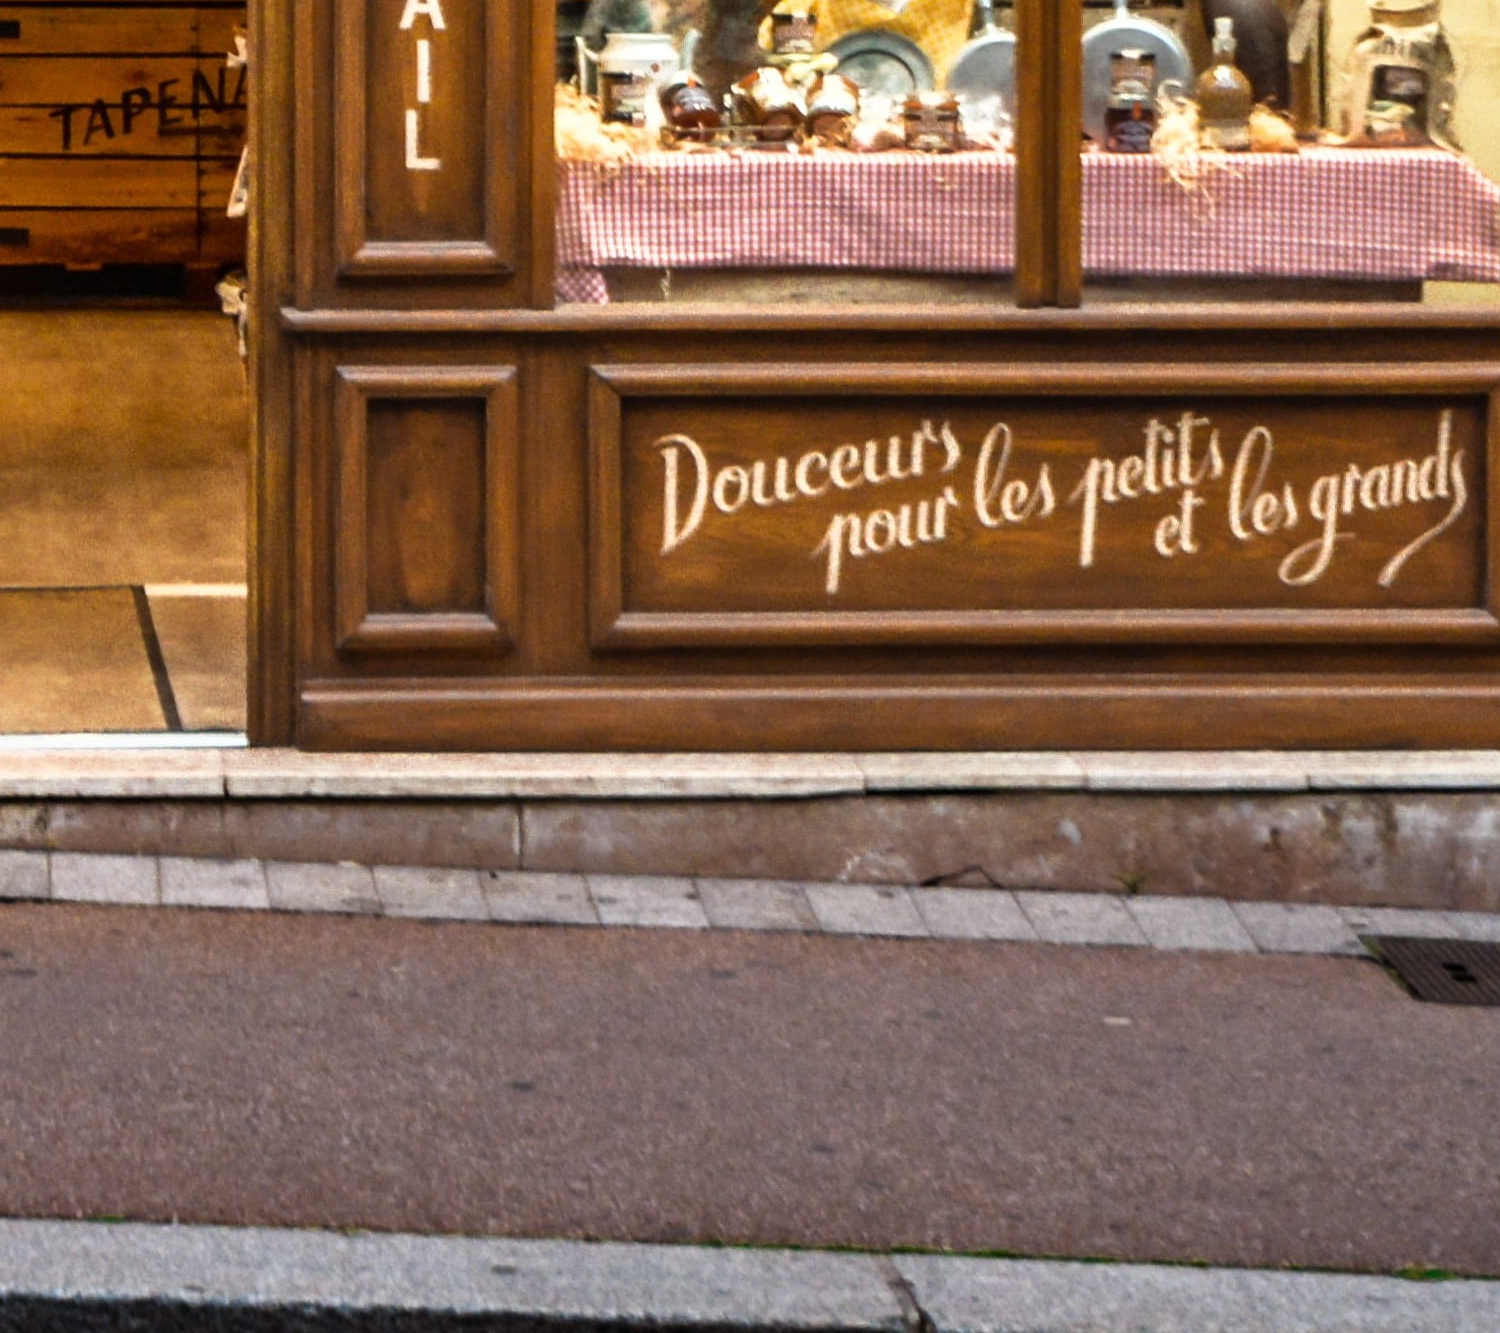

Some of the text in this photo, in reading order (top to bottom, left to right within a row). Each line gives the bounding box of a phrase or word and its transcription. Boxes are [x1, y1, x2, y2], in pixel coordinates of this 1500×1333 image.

[654, 409, 1468, 594] Douceurs pour les petits et les grands
